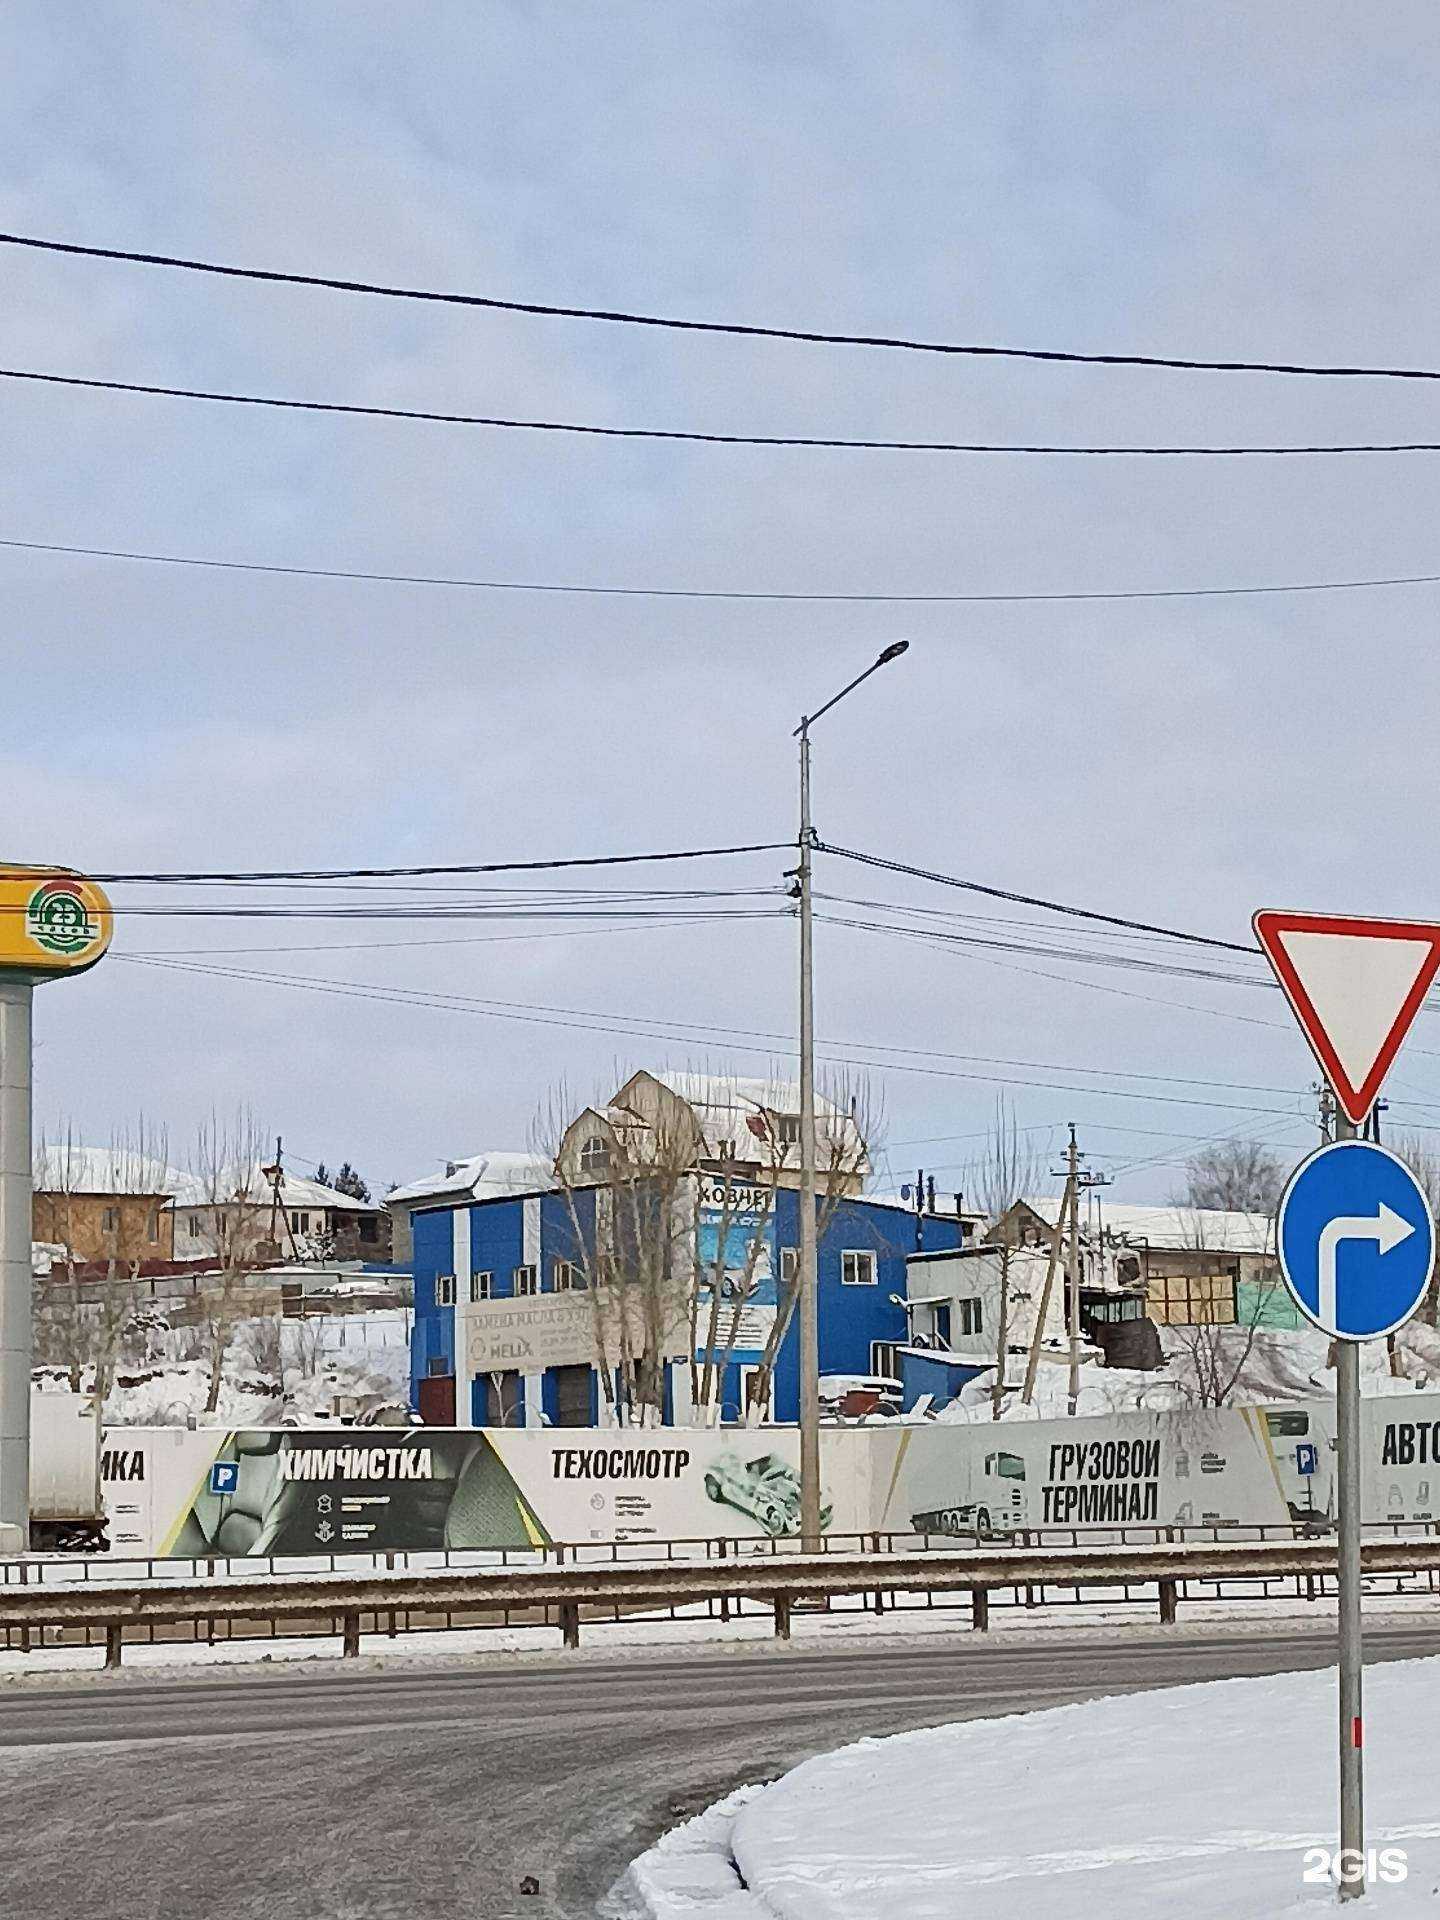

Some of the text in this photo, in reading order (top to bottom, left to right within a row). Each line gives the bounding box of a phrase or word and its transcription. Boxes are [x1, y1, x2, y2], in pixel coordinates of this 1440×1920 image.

[278, 1448, 433, 1481] ХИМЧИСТКА
[551, 1449, 690, 1479] ТЕХОСМОТР
[1041, 1481, 1158, 1523] ТЕРМИНАЛ
